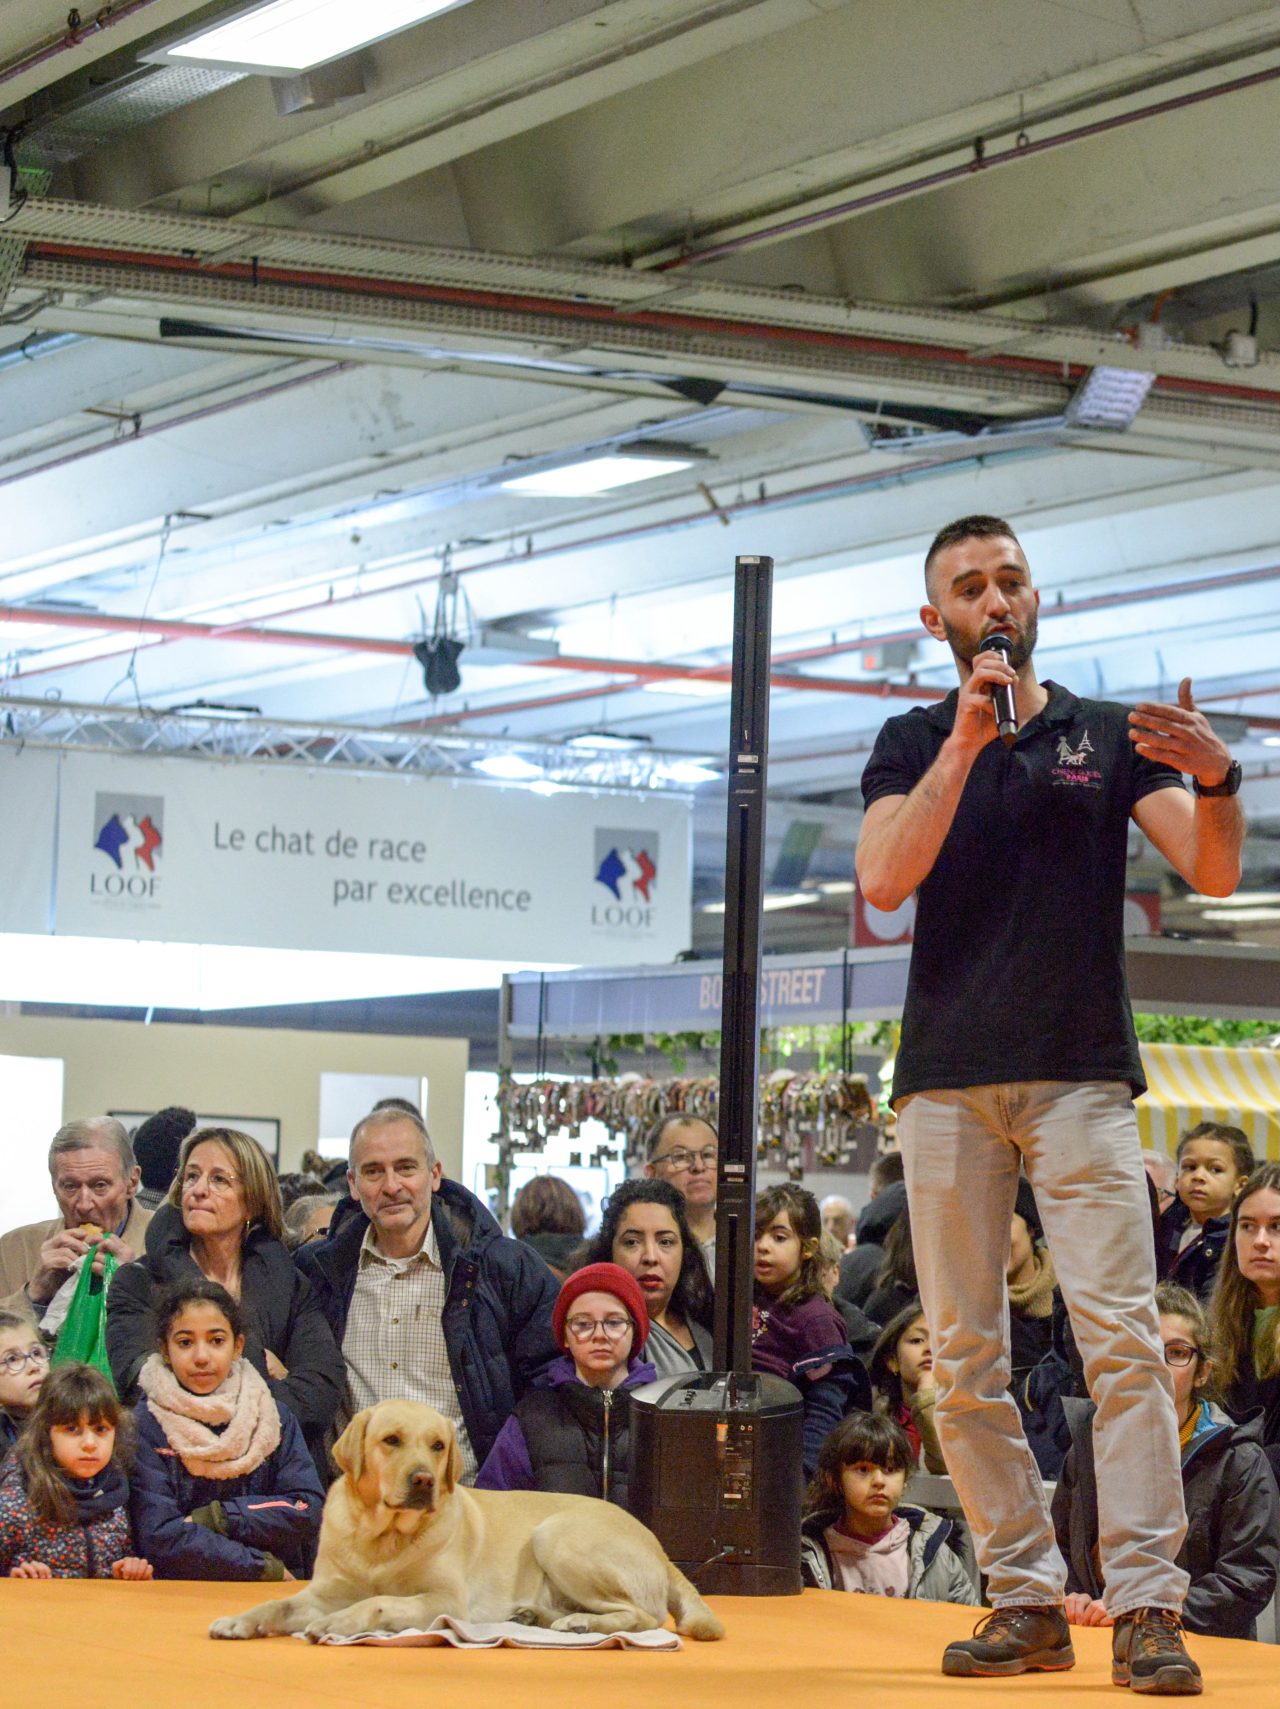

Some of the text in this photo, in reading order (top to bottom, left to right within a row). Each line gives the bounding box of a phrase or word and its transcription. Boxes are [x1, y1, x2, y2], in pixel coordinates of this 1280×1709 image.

[214, 821, 427, 862] Le chat de race
[90, 872, 161, 898] LOOF
[333, 878, 532, 912] par excellence
[591, 903, 657, 929] LOOF
